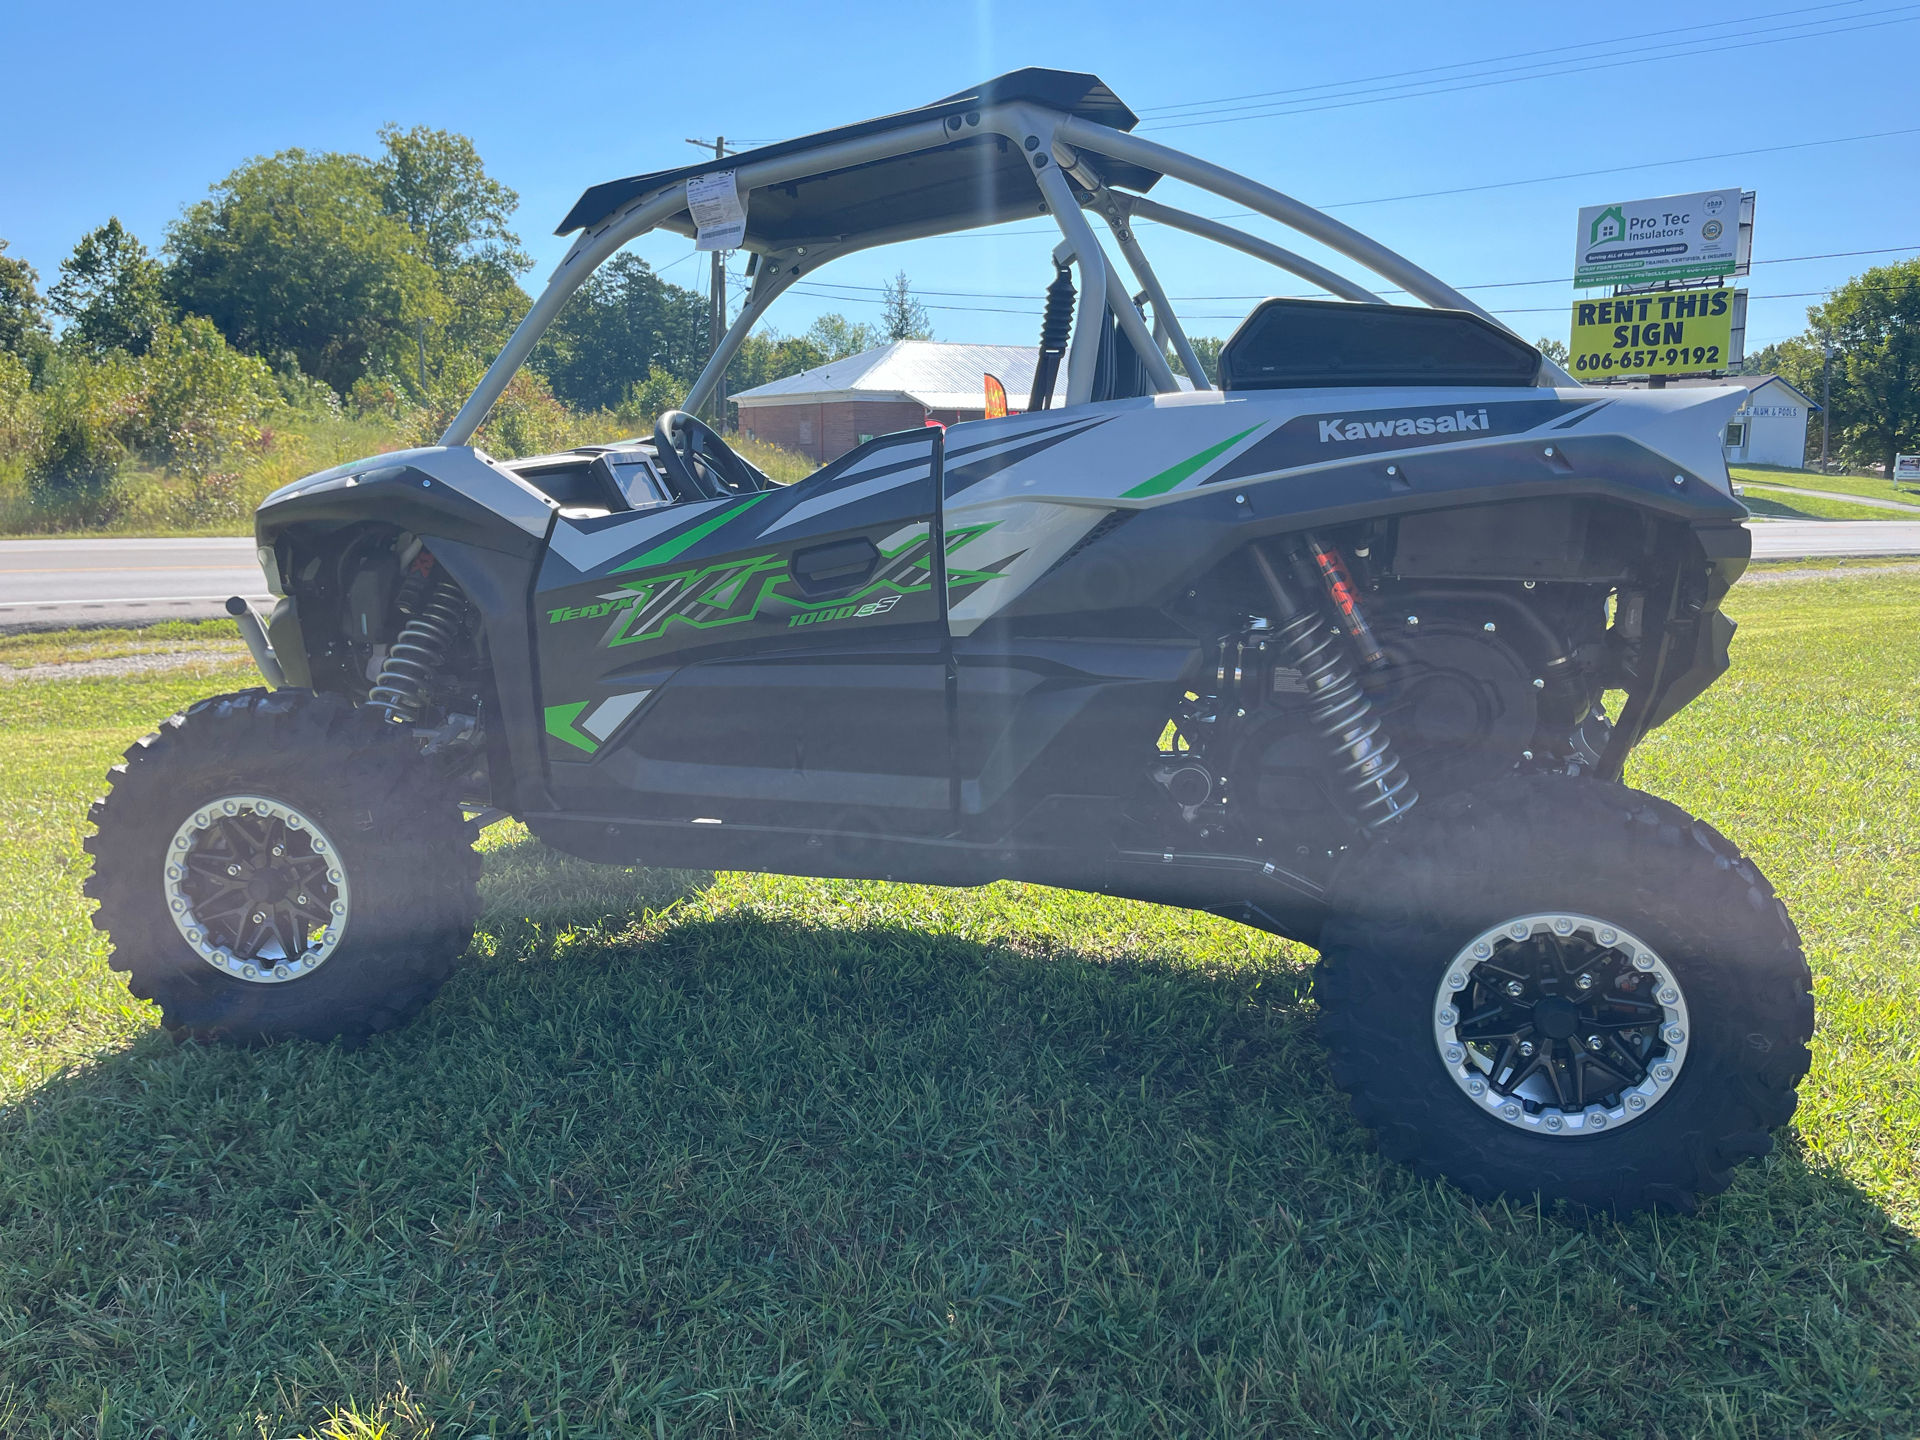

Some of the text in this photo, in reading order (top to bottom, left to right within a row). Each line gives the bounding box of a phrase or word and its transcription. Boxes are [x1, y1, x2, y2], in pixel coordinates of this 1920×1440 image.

[1630, 212, 1690, 231] Pro Tec
[1629, 227, 1684, 242] Insulators
[1588, 253, 1607, 261] Serving
[1635, 248, 1665, 256] INSULATION
[1645, 258, 1670, 266] TRAINED,
[1671, 255, 1701, 264] CERTIFIED,
[1707, 252, 1733, 260] INSURED
[1612, 261, 1643, 269] SPECIALIST
[1578, 291, 1729, 326] RENT THIS
[1613, 321, 1684, 349] SIGN
[1576, 345, 1719, 371] 606-657-9192
[1772, 407, 1777, 416] &
[1778, 407, 1797, 417] POOLS
[1318, 409, 1490, 443] Kawasaki
